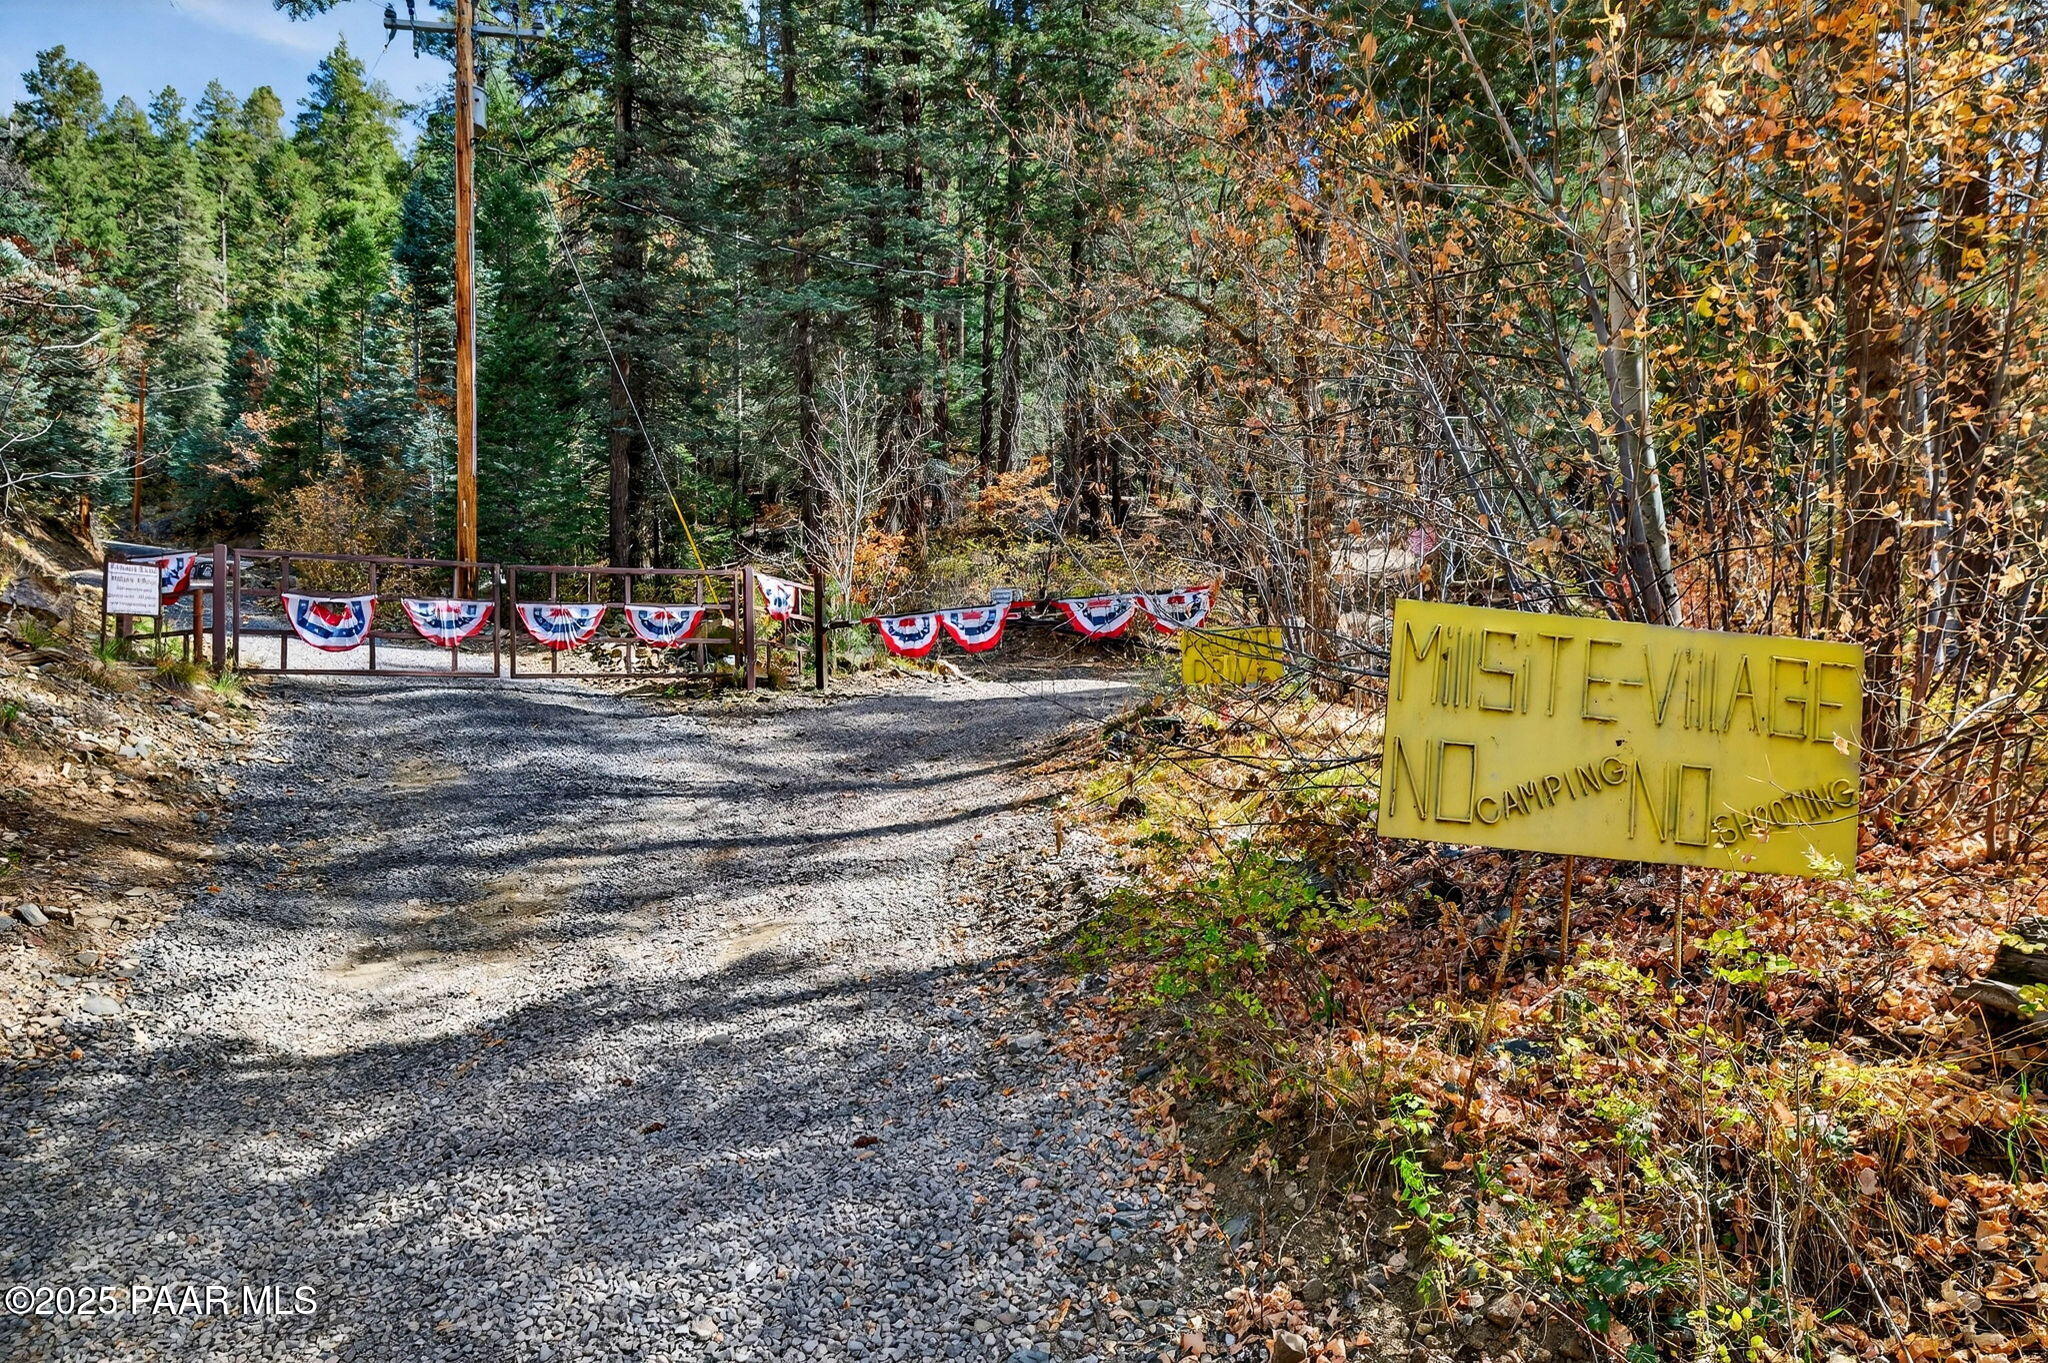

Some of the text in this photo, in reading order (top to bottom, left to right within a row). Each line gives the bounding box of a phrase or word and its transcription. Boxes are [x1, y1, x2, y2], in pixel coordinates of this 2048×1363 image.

[1389, 735, 1854, 847] NO CAMPING NO SHOOTING
